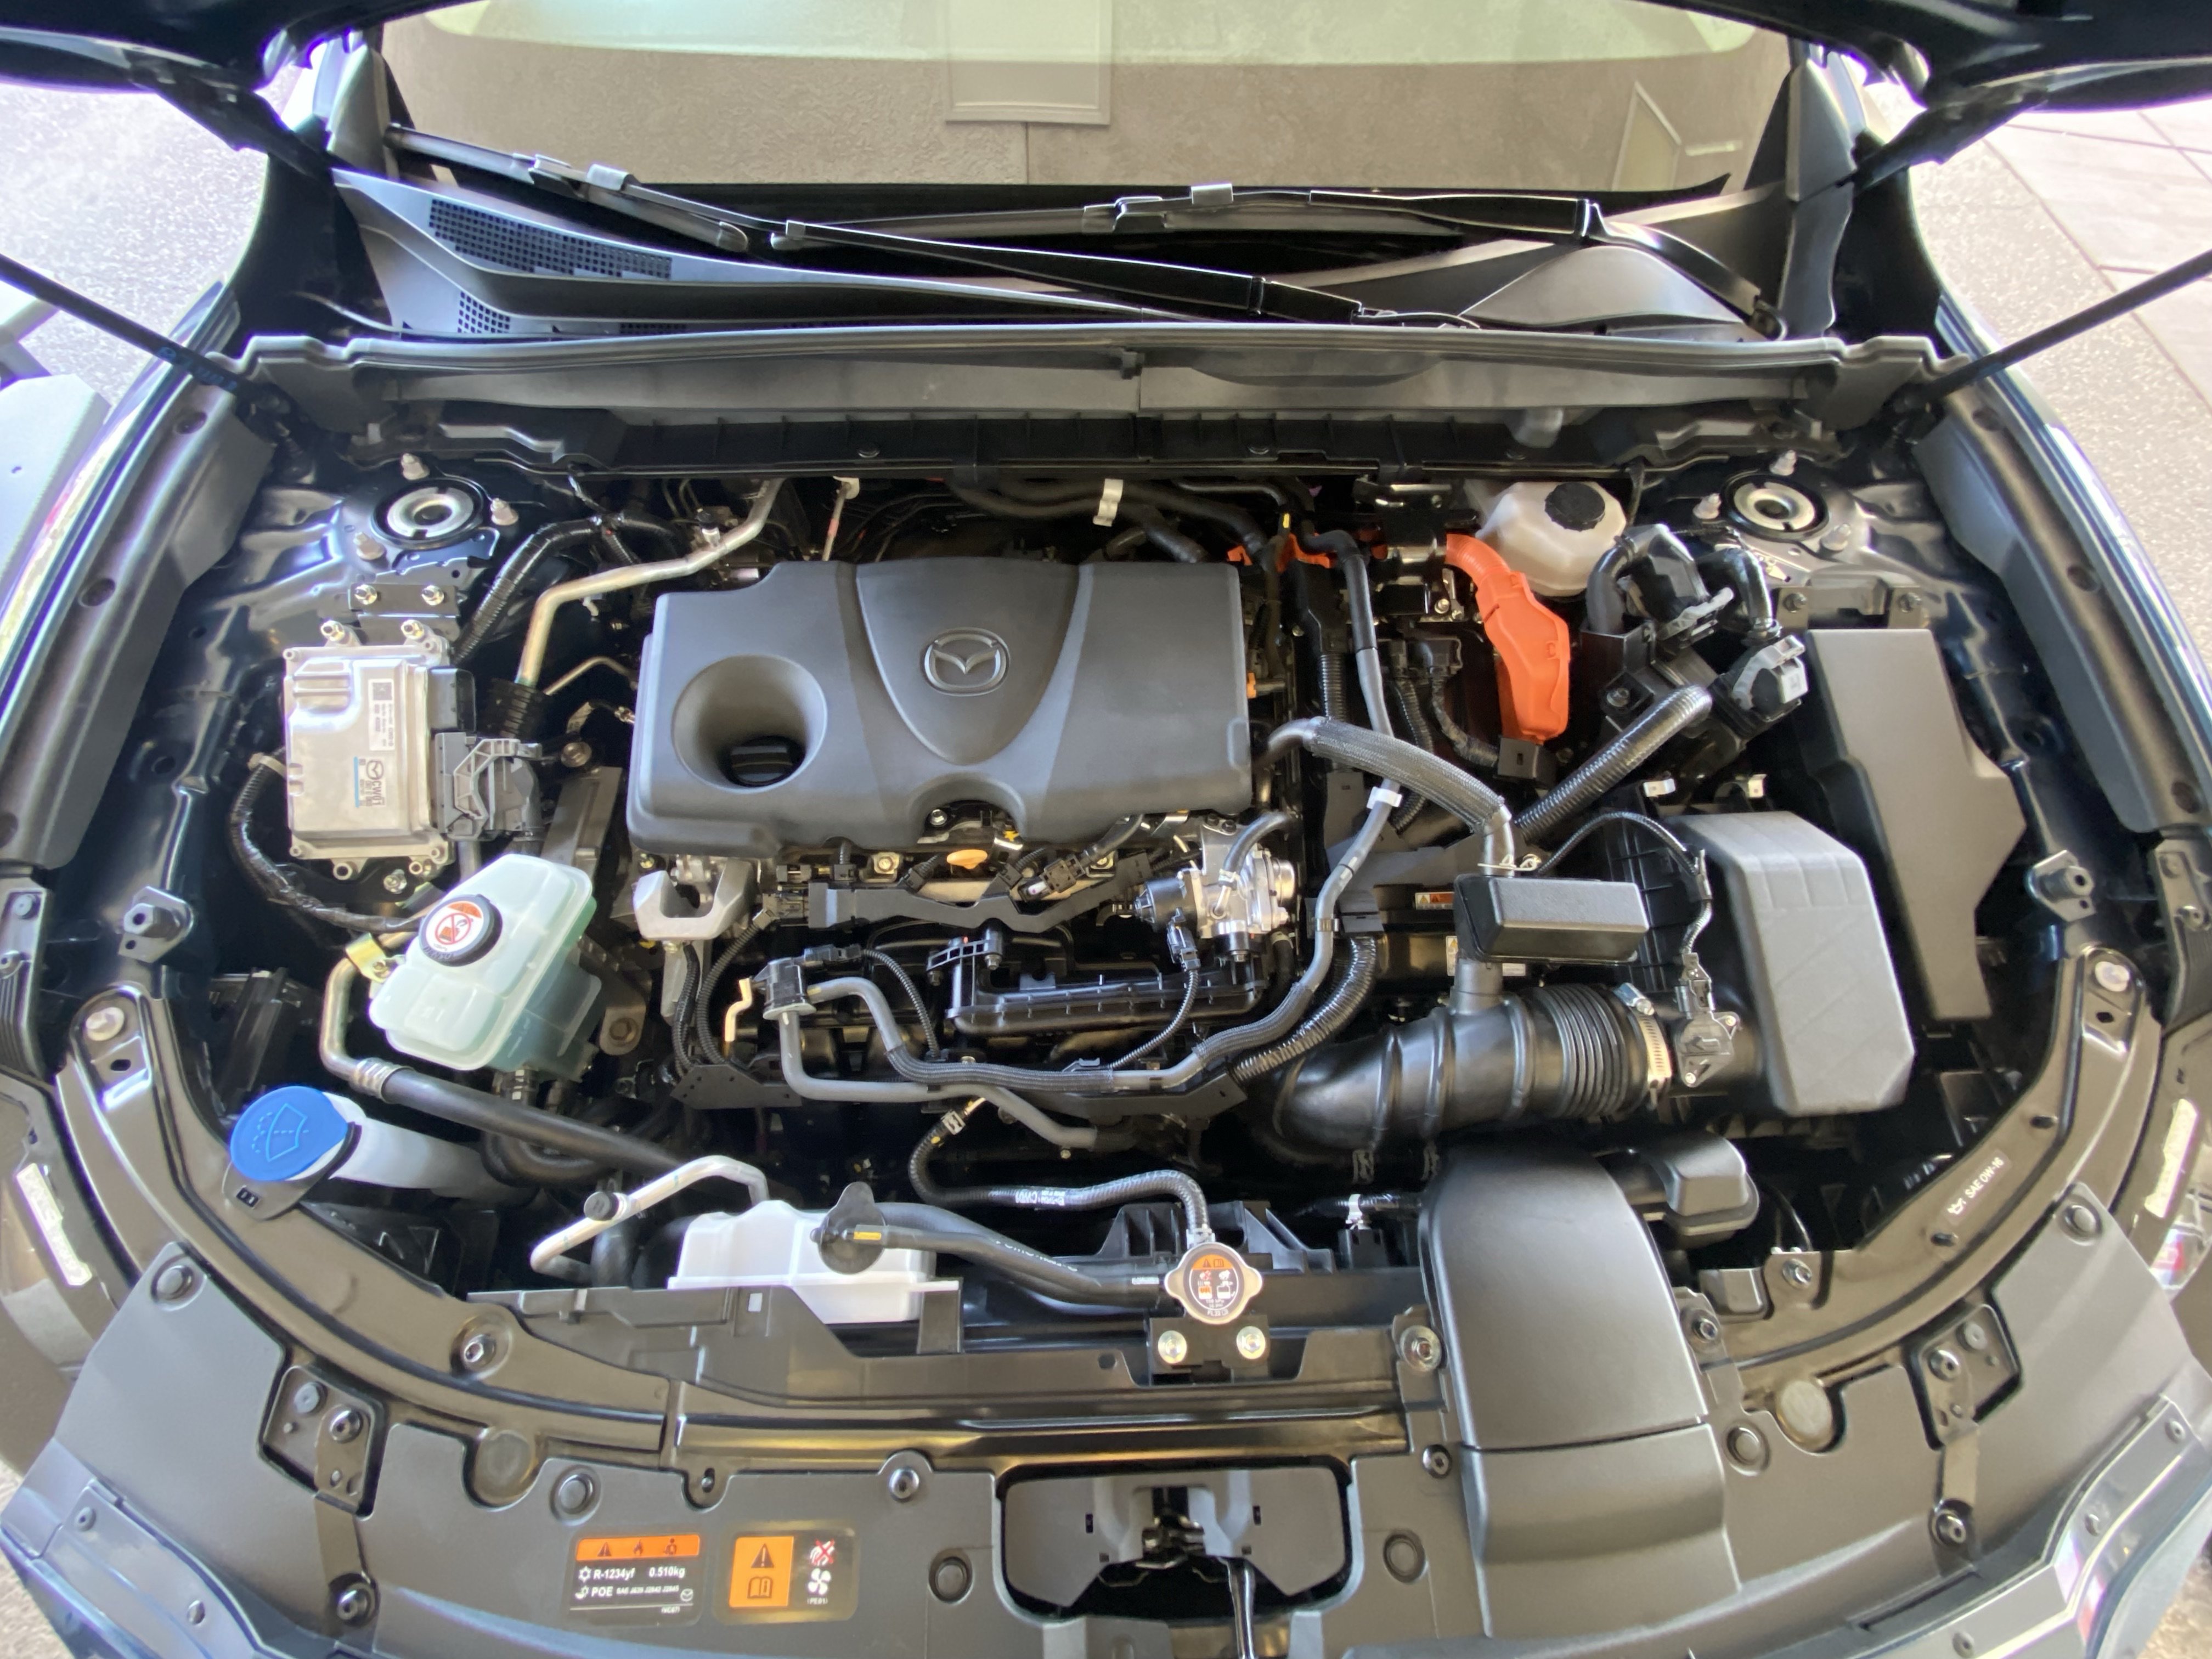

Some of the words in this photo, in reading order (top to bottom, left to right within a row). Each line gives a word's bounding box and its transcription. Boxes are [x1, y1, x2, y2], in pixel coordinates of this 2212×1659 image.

[1965, 1179, 1984, 1199] SAE
[1979, 1156, 2005, 1183] 0W-16
[593, 1567, 635, 1581] R-1234yf
[648, 1566, 685, 1578] 0.510kg
[591, 1586, 613, 1597] POE
